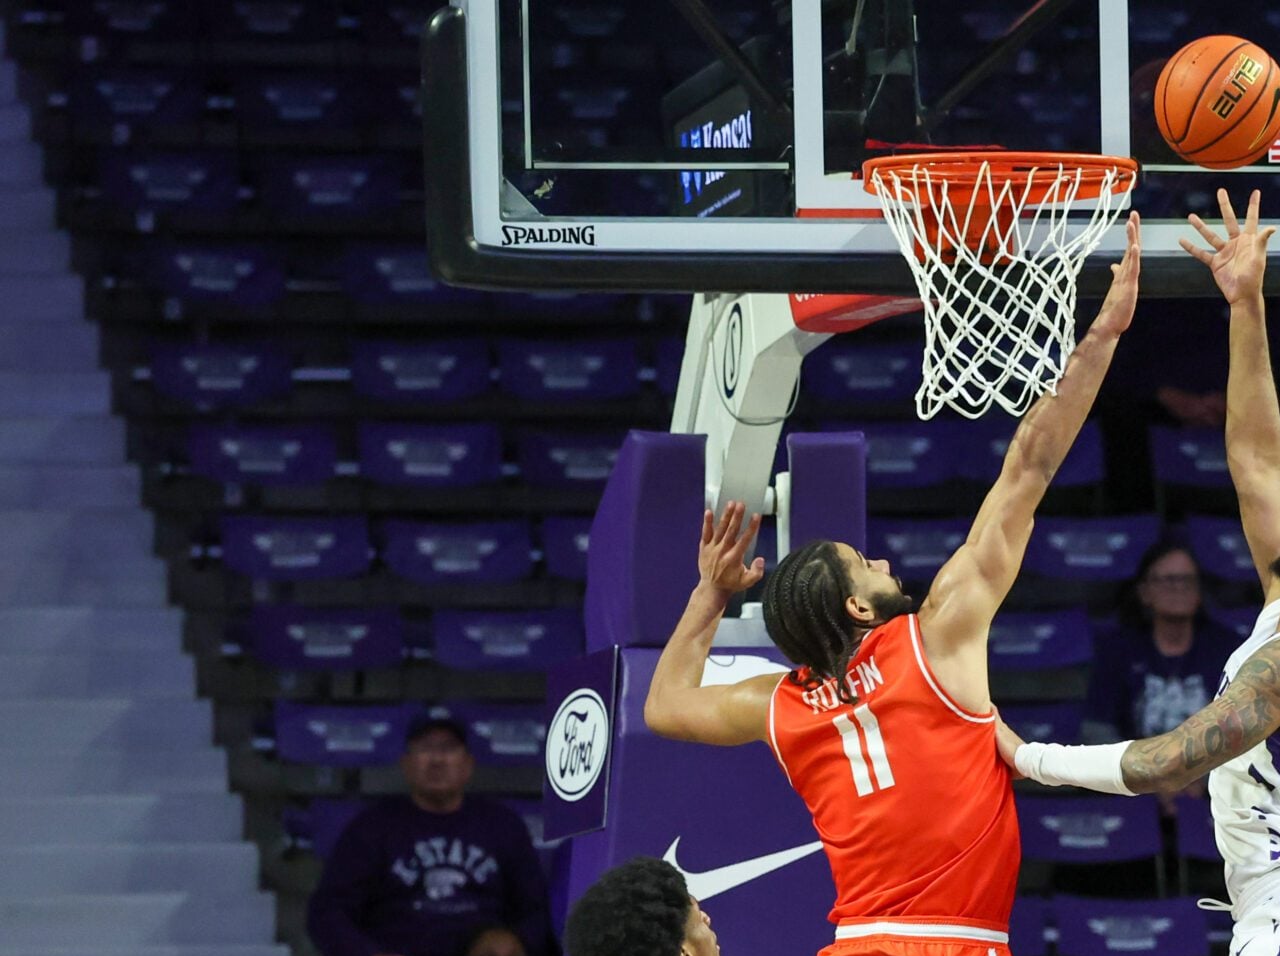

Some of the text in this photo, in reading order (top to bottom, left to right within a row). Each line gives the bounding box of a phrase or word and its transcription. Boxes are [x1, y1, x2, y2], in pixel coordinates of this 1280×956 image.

[1211, 57, 1264, 121] ELITE
[501, 224, 596, 246] SPALDING
[801, 655, 884, 715] RUFIN
[559, 710, 597, 779] Ford
[832, 702, 896, 798] 11
